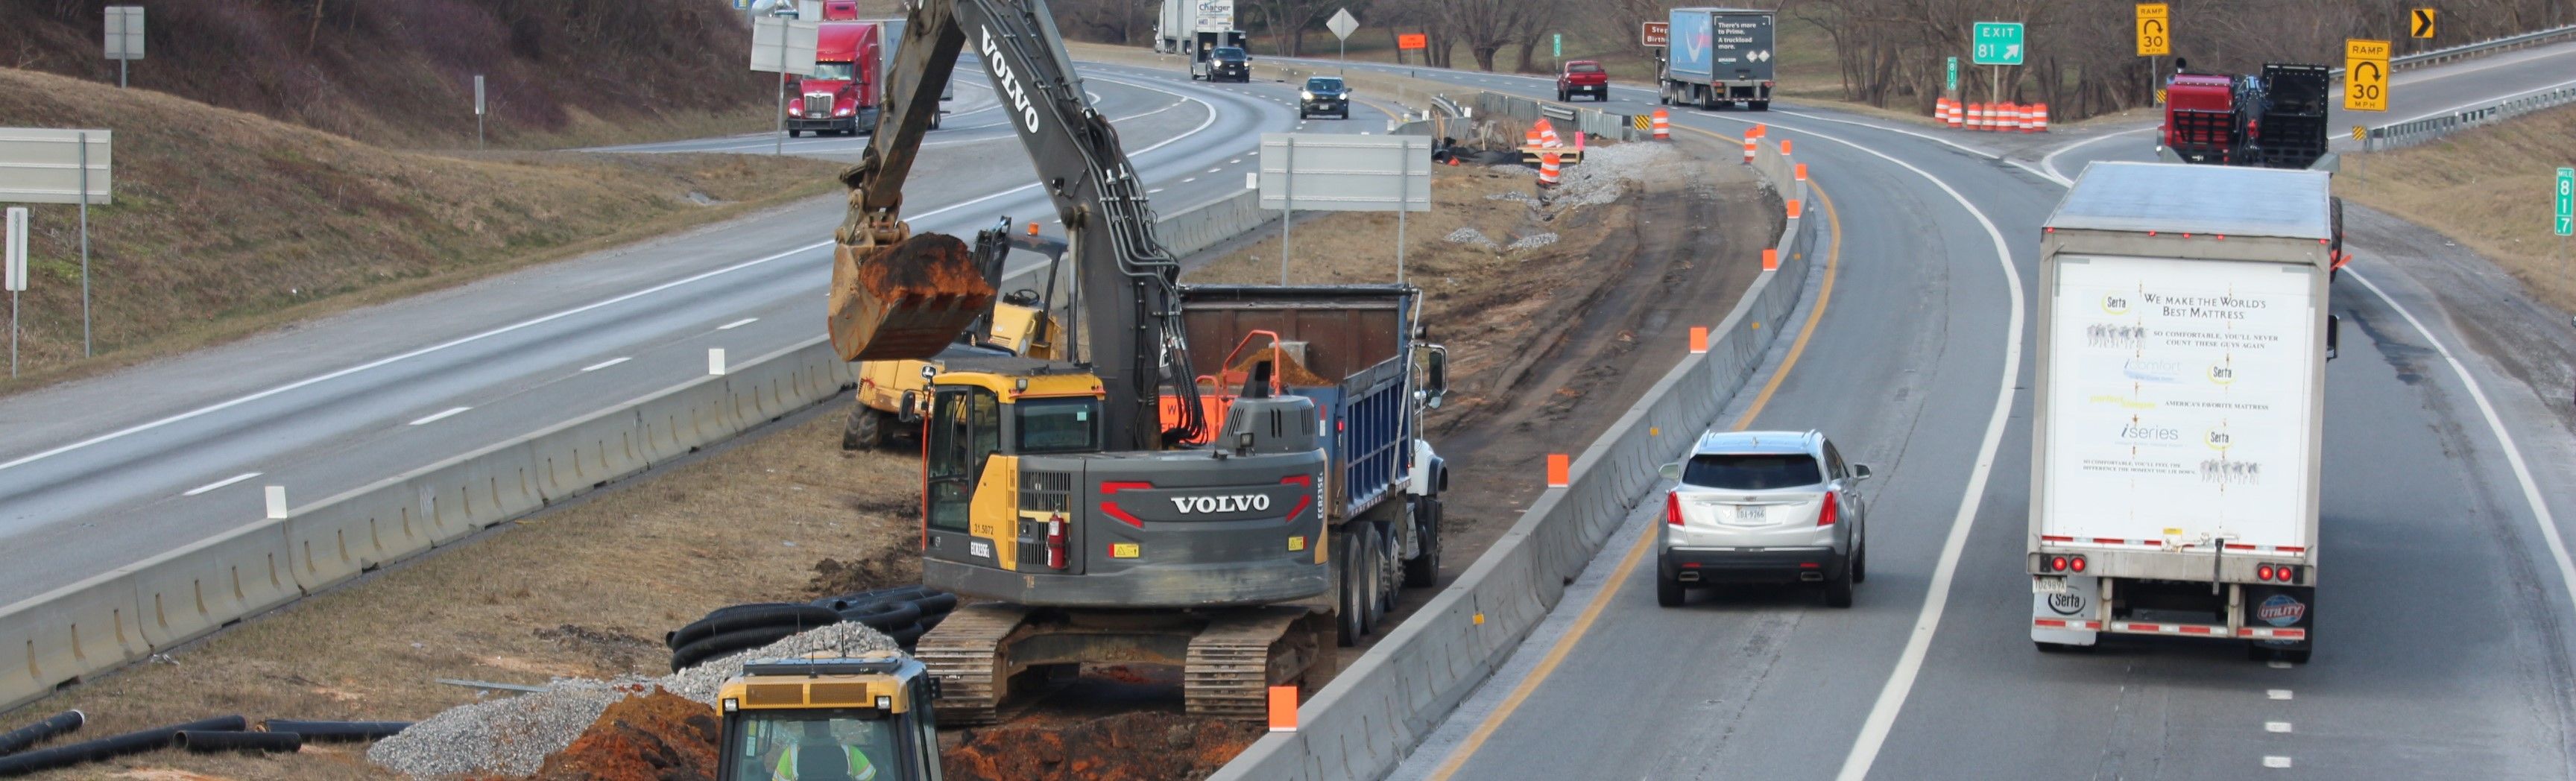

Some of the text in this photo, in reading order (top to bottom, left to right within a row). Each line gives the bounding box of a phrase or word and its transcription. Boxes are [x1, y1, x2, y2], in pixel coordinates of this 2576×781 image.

[1983, 28, 2014, 38] EXIT
[2143, 36, 2162, 47] 30
[1978, 44, 1995, 57] 81
[2352, 45, 2383, 54] RAMP
[981, 24, 1039, 134] VOLVO
[2352, 83, 2379, 100] 30
[2107, 297, 2126, 308] Serta
[2144, 293, 2266, 309] WE MAKE THE WORLD'S
[2163, 306, 2244, 320] BEST MATTRESS
[2213, 367, 2232, 378] Serta
[2210, 431, 2229, 443] Serta
[1170, 494, 1269, 513] VOLVO
[2055, 593, 2080, 608] Serta
[2260, 605, 2302, 618] UTILITY
